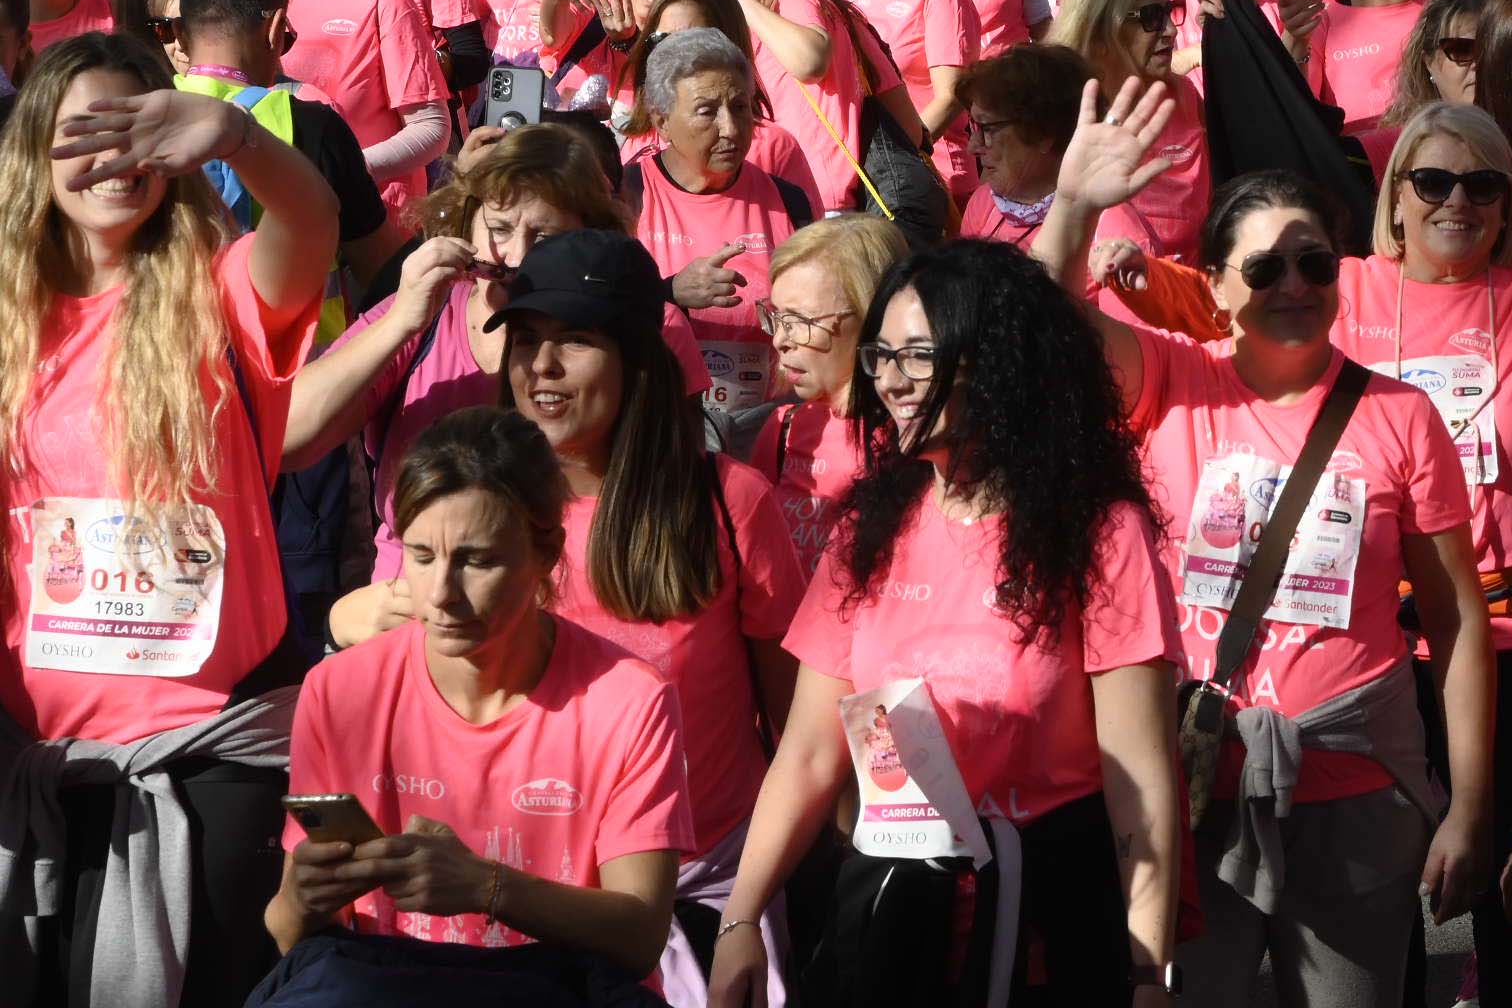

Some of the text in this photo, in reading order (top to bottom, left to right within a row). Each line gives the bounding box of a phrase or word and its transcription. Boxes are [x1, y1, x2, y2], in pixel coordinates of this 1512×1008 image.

[1333, 43, 1380, 60] OYSHO
[1452, 370, 1481, 379] SUMA
[1459, 445, 1475, 455] 202
[91, 569, 155, 593] 016
[1312, 576, 1337, 591] 2023
[95, 601, 145, 616] 17983
[48, 620, 193, 637] CARRERA DE LA MUJER 202
[41, 641, 93, 658] OYSHO
[881, 805, 926, 818] CARRERA
[873, 831, 927, 844] OYSHO
